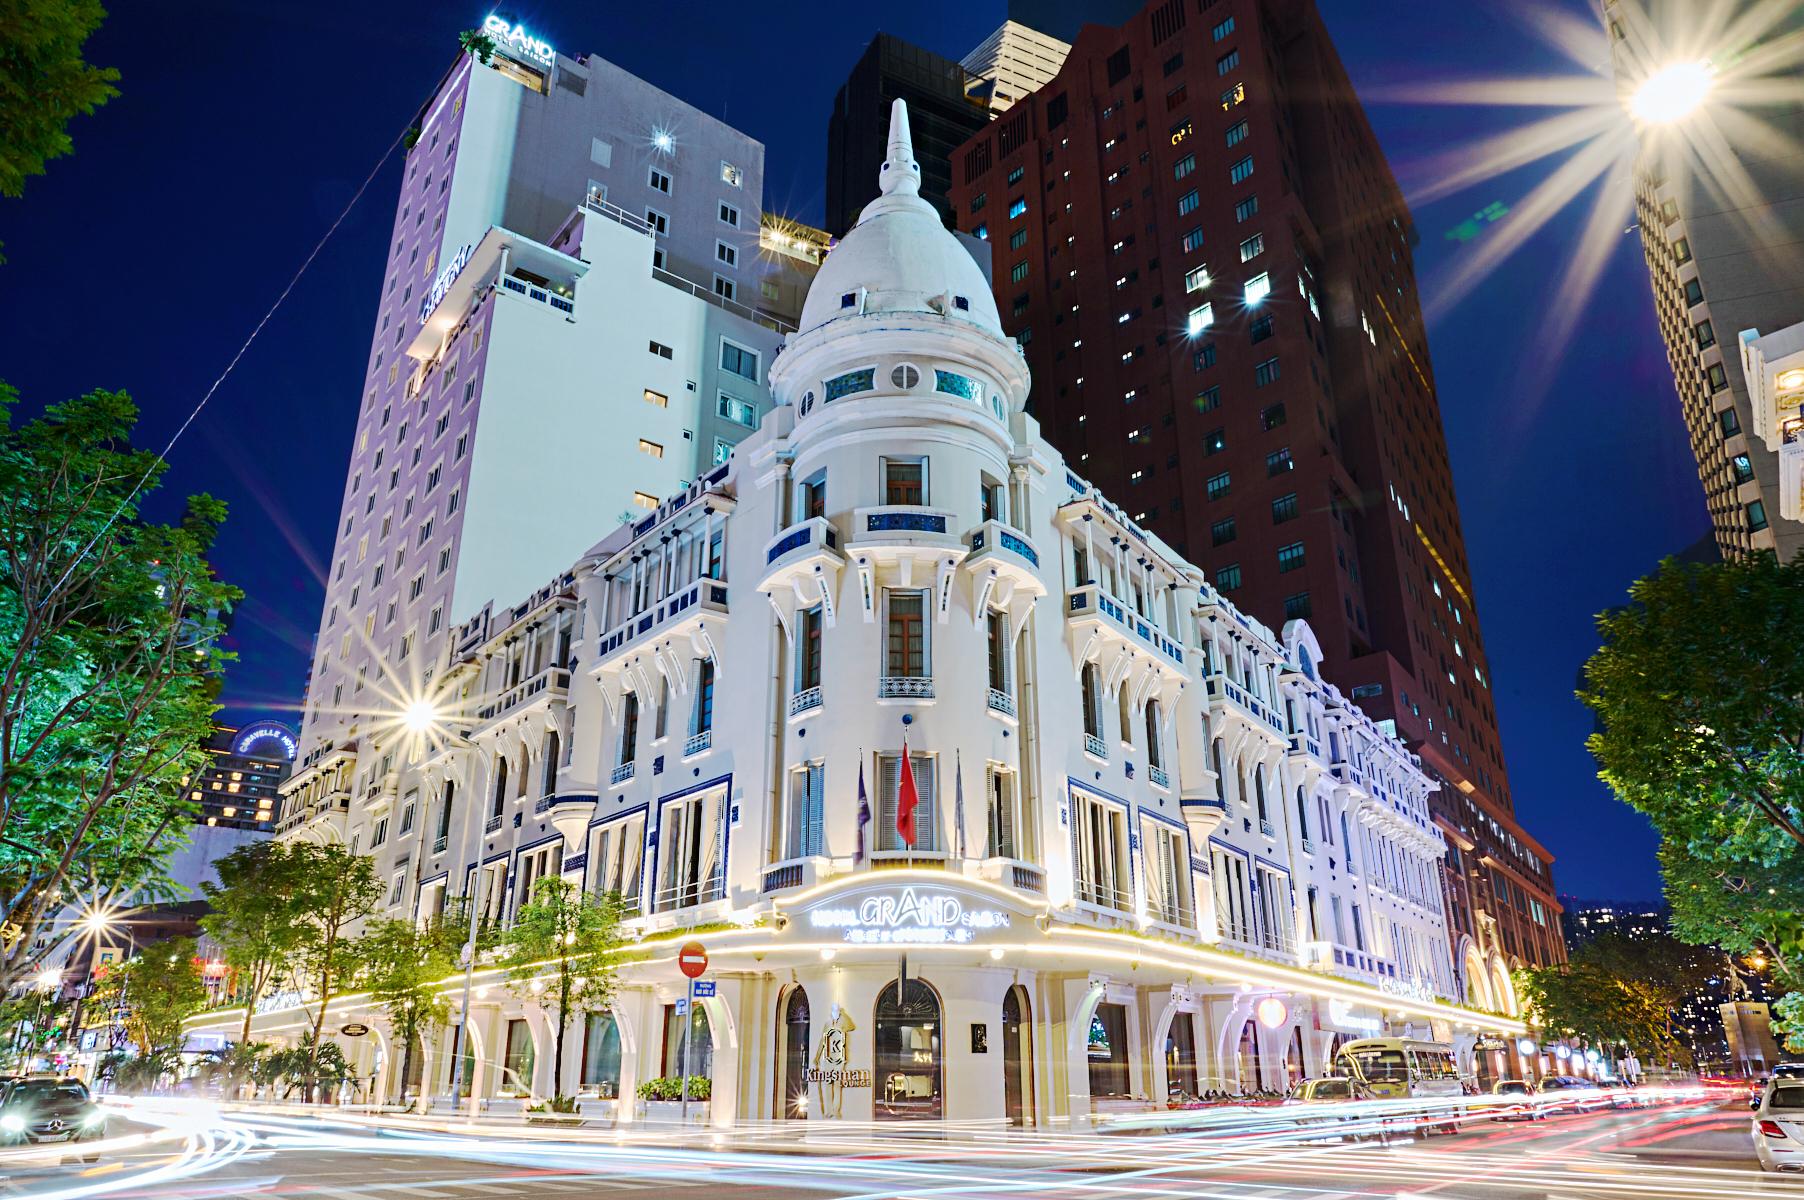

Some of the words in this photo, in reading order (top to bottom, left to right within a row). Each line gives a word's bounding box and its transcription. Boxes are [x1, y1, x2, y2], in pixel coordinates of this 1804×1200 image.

[483, 30, 513, 47] HOTEL
[518, 46, 552, 67] SAIGON
[485, 15, 553, 59] GRAND
[860, 887, 962, 926] GRAND
[832, 1039, 841, 1053] K
[805, 1067, 871, 1083] Kingsman
[839, 1079, 871, 1088] LOUNGE
